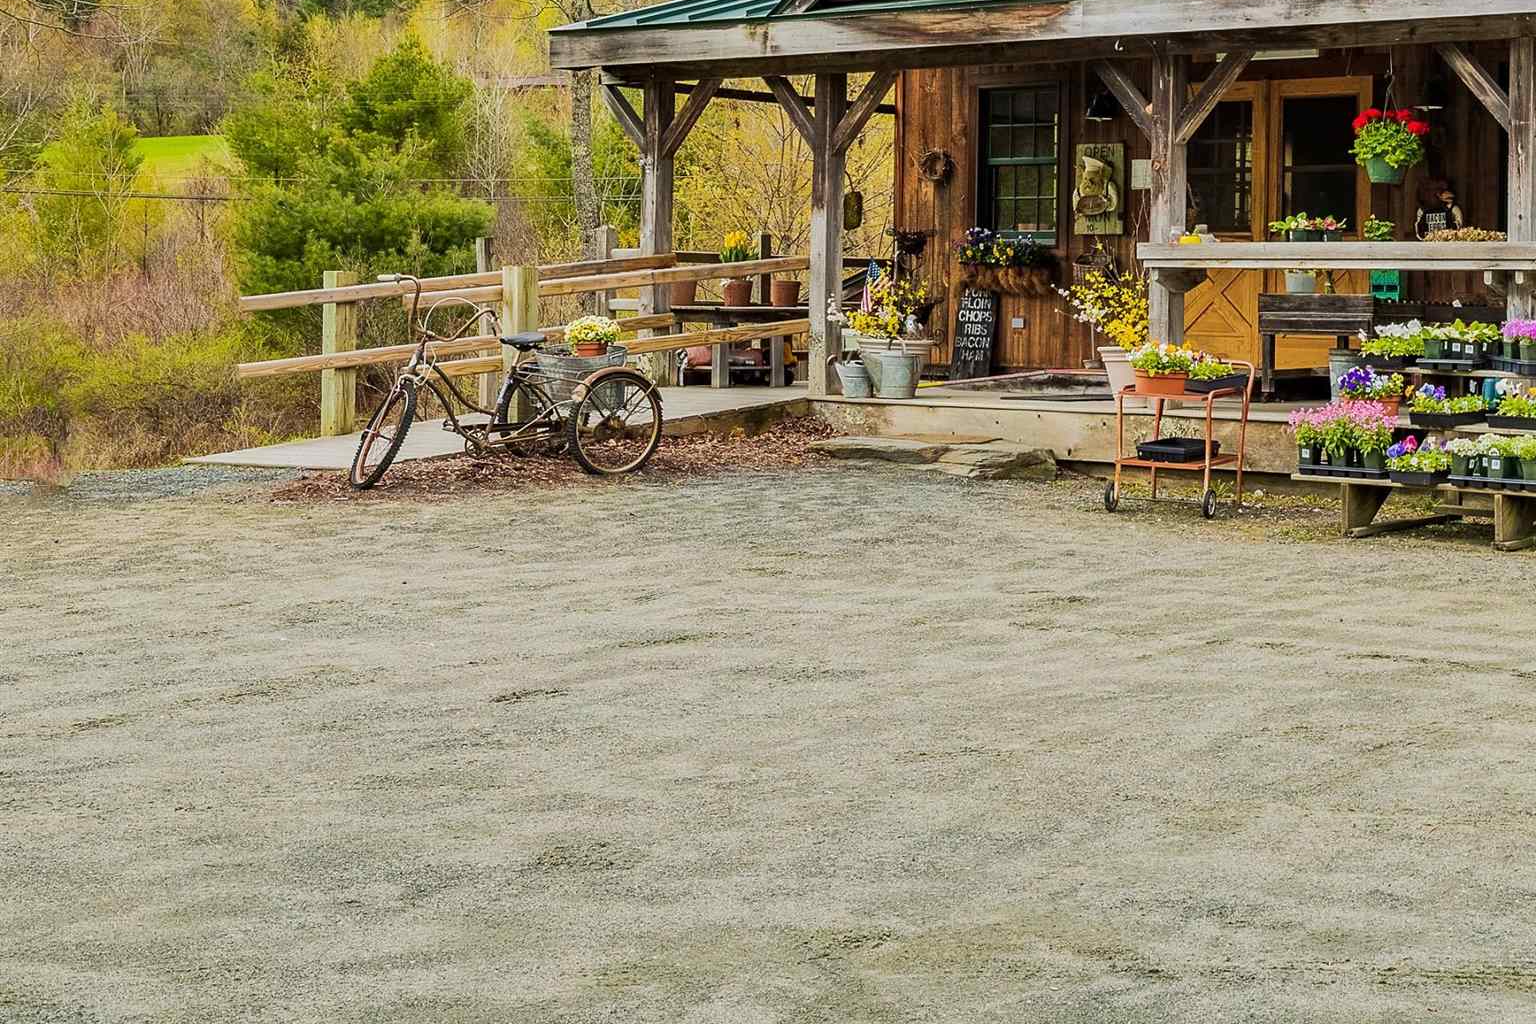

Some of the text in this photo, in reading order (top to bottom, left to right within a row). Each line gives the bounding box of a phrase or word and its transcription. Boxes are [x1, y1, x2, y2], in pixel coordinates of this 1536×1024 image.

[1084, 144, 1115, 157] OPEN
[958, 310, 993, 322] CHOPS
[964, 323, 988, 335] RIBS
[955, 336, 990, 349] BACON
[961, 349, 984, 361] HAM
